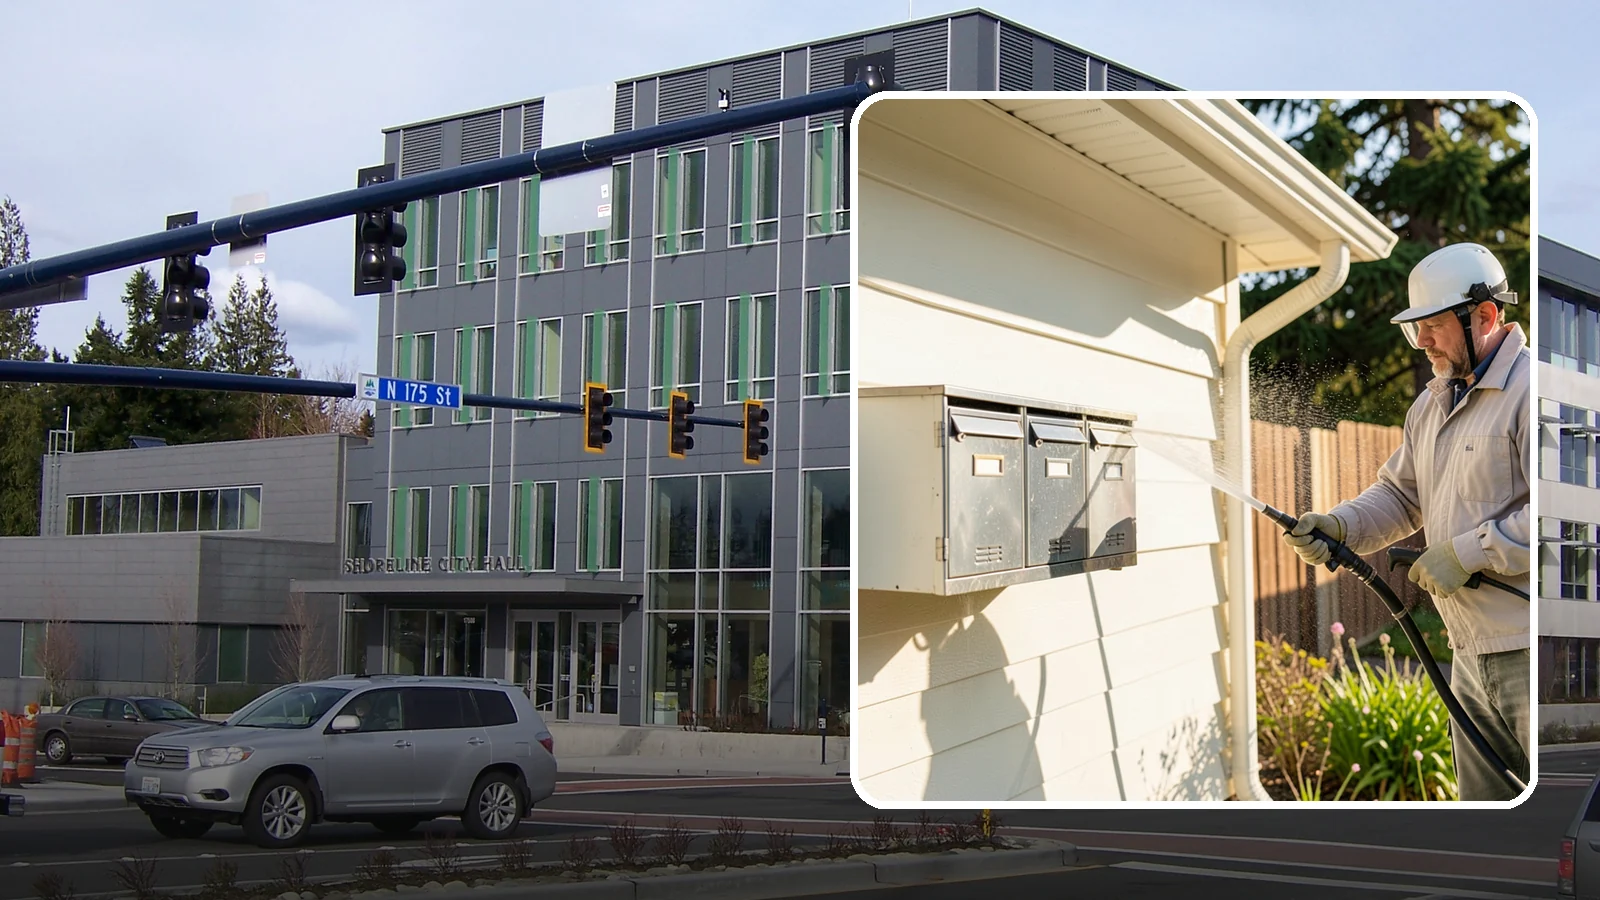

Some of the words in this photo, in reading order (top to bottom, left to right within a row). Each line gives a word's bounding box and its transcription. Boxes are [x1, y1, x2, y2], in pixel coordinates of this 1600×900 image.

[387, 380, 396, 400] N
[405, 382, 427, 403] 175
[436, 386, 451, 406] St
[344, 557, 432, 574] SHORELINE
[438, 557, 475, 572] CITY
[484, 555, 525, 571] HALL
